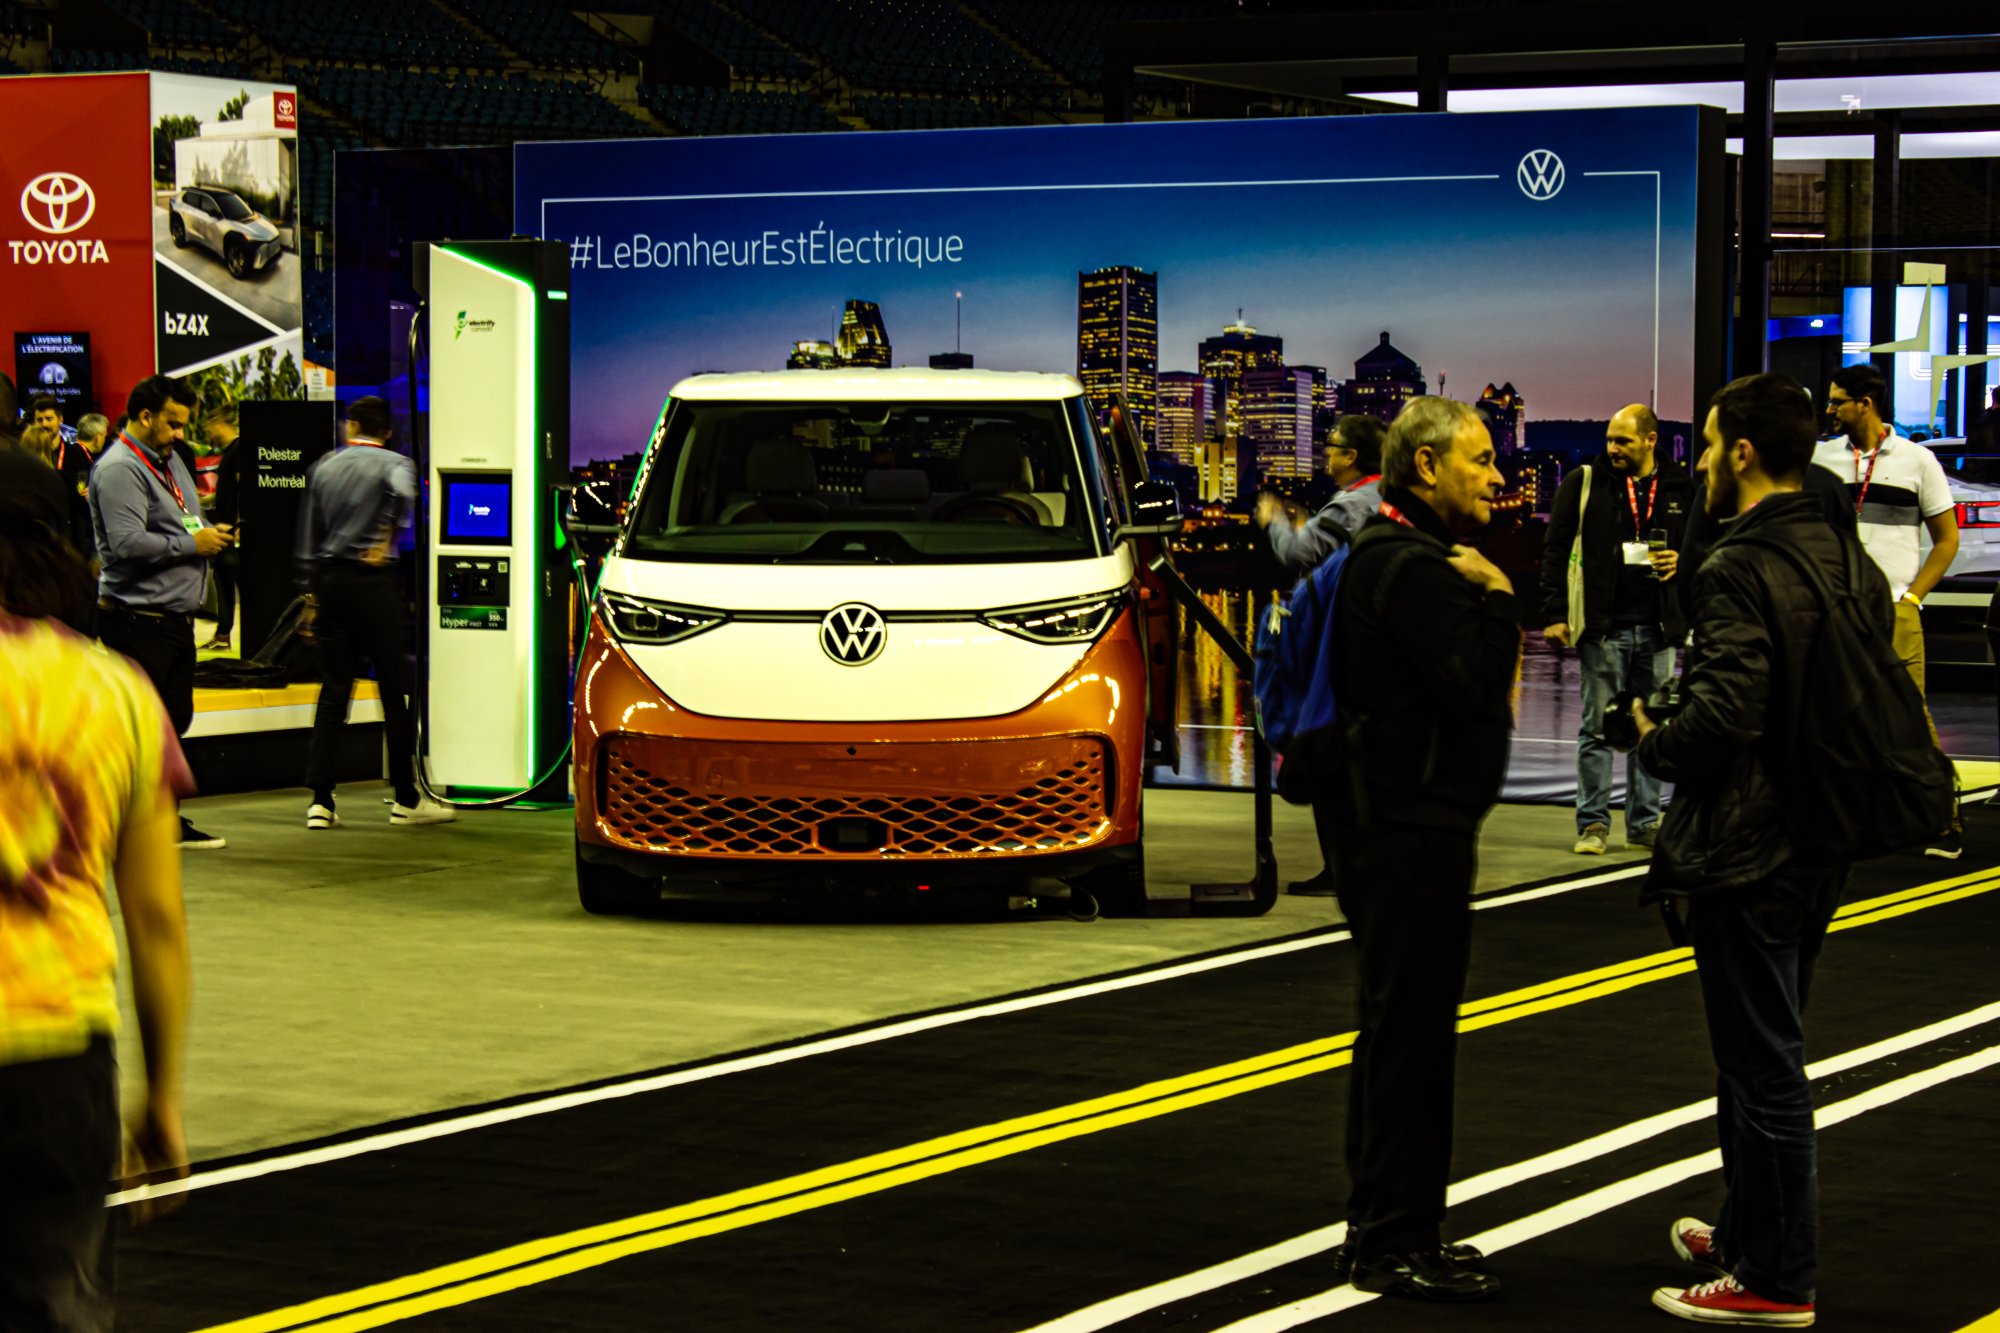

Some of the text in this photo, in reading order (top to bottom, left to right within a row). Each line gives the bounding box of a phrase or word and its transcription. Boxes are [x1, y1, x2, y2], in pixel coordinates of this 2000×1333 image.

[1517, 149, 1565, 200] VW
[8, 239, 110, 264] TOYOTA
[569, 220, 964, 270] #LeBonheurEstÉlectrique
[164, 310, 210, 337] bZ4X
[32, 335, 73, 345] L'AVENIR DE
[258, 446, 302, 461] Polestar
[258, 473, 306, 489] Montréal
[441, 616, 469, 629] Hyper
[820, 602, 887, 667] VW
